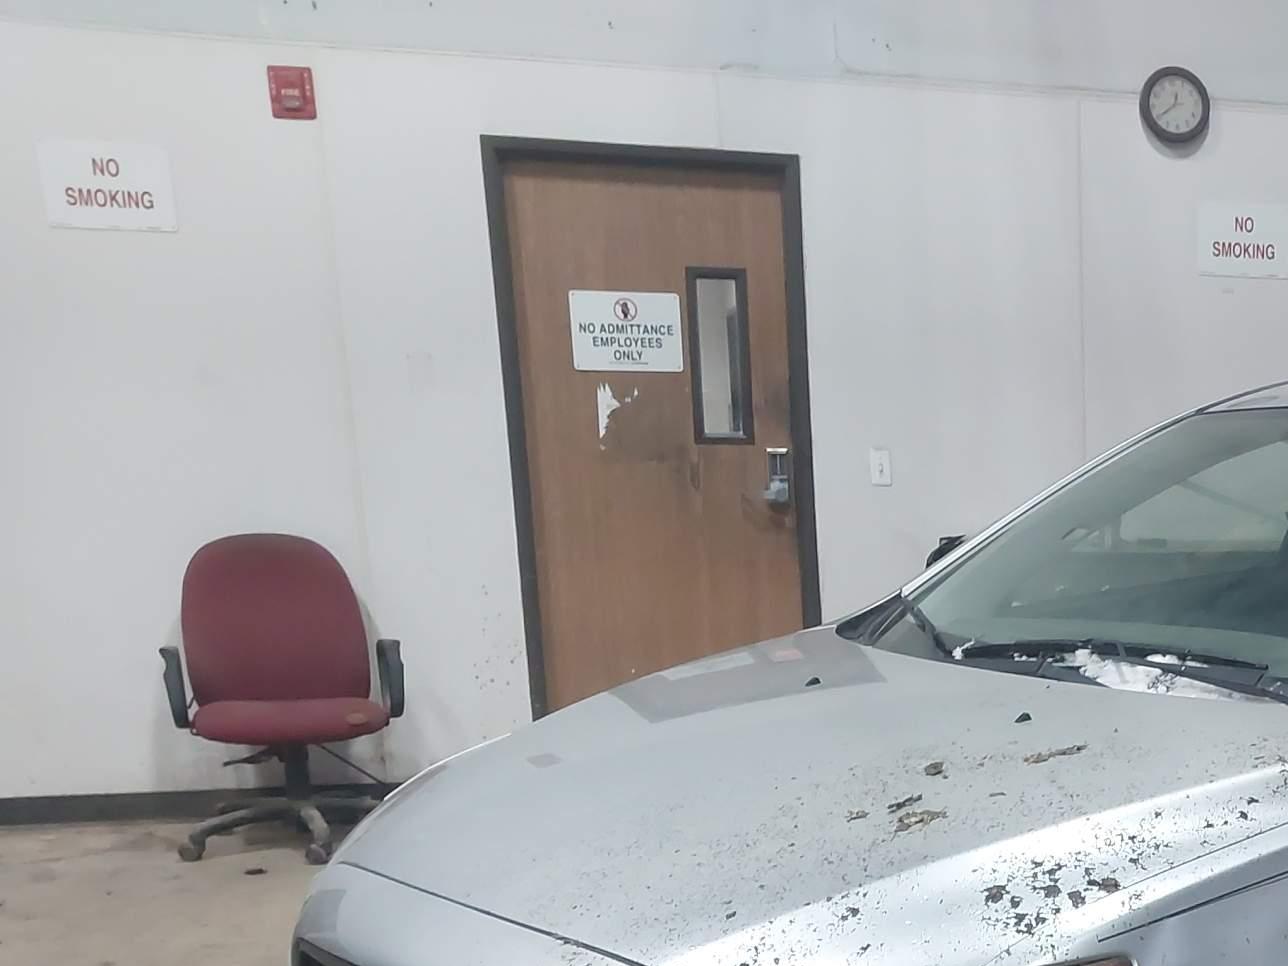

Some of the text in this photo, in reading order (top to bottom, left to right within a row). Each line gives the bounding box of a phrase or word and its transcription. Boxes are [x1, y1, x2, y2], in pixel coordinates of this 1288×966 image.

[91, 157, 120, 177] NO
[64, 186, 154, 210] SMOKING
[1234, 216, 1255, 233] NO
[1212, 241, 1275, 260] SMOKING
[579, 322, 674, 335] NO ADMITTANCE
[592, 336, 663, 348] EMPLOYEES
[613, 349, 643, 361] ONLY
